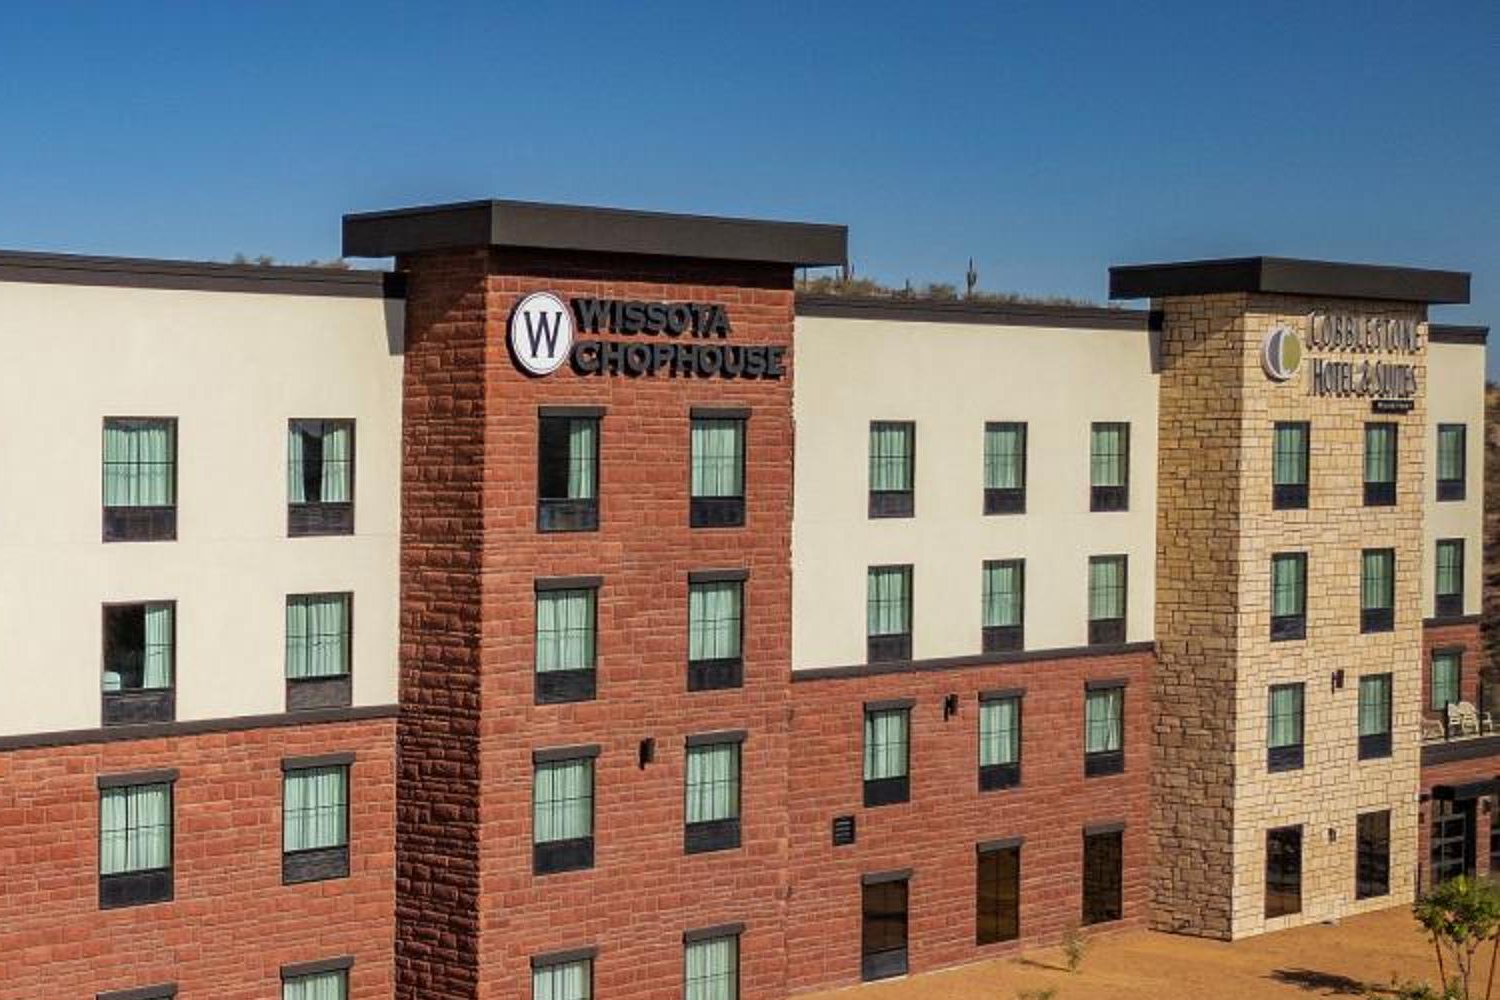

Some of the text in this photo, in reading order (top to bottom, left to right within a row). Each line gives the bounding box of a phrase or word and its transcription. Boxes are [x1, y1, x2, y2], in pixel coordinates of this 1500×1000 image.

[523, 311, 562, 358] W
[575, 298, 731, 338] WISSOTA
[1305, 311, 1422, 355] COBBLESTONE
[572, 341, 786, 378] CHOPHOUSE
[1308, 358, 1355, 397] HOTEL
[1373, 360, 1417, 398] SUITES
